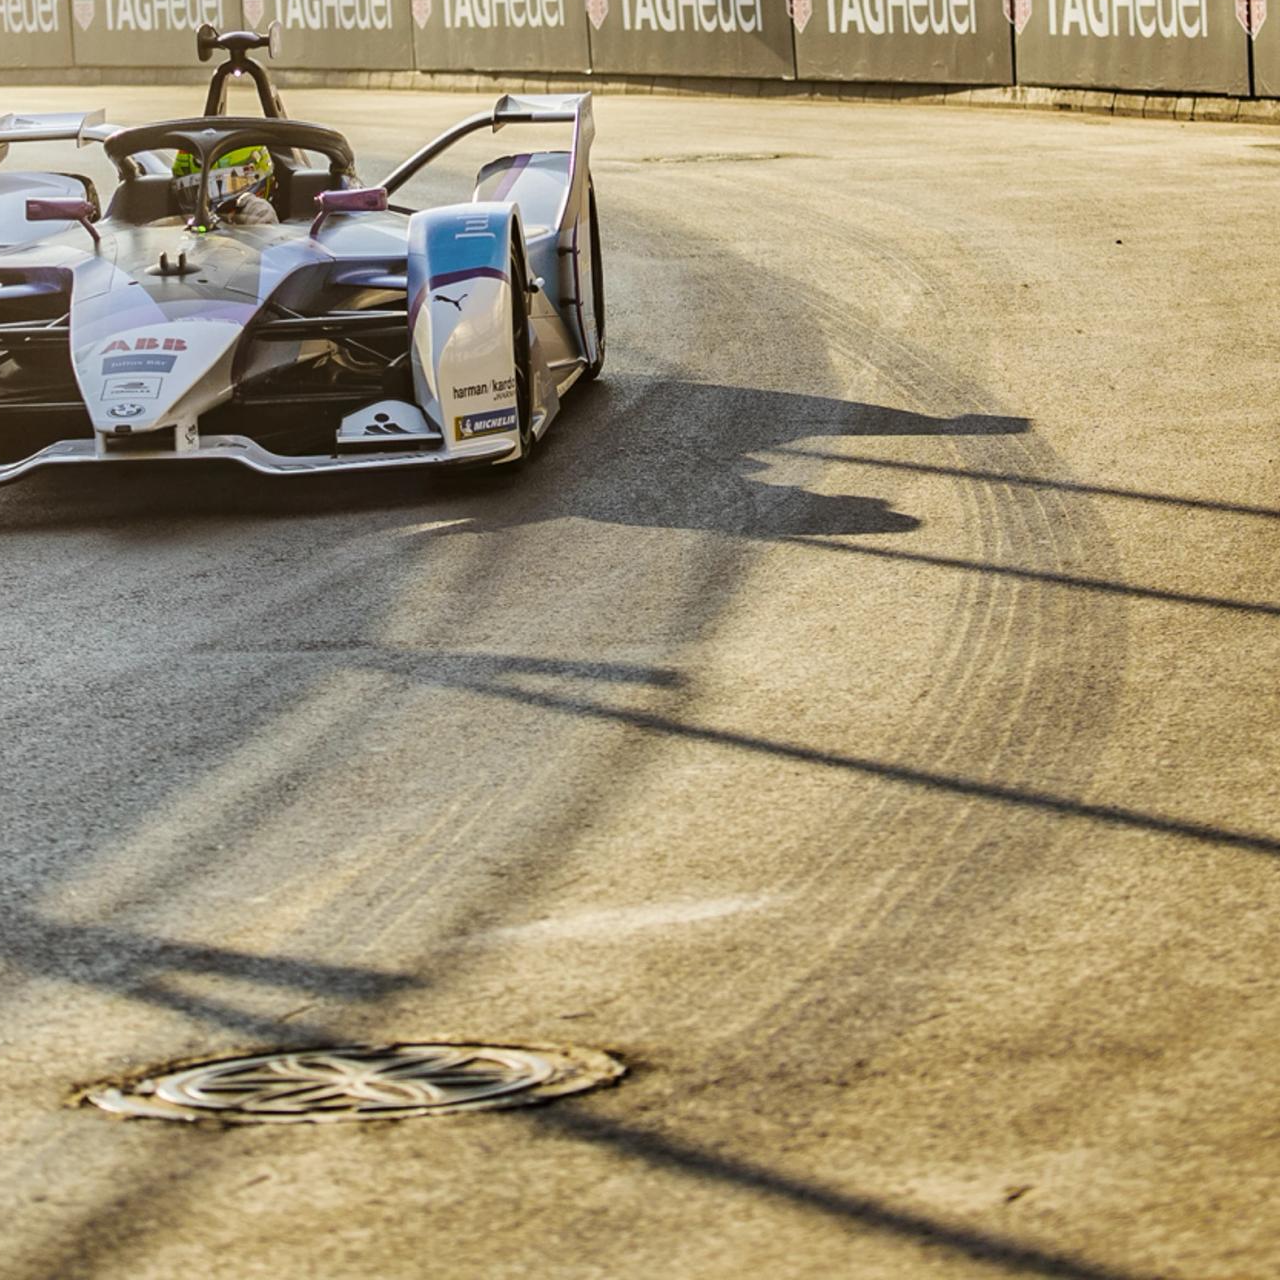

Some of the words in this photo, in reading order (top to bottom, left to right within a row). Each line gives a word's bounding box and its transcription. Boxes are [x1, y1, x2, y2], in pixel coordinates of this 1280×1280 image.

[99, 337, 188, 356] ABB
[452, 383, 488, 400] harman
[491, 377, 516, 392] kardo
[473, 415, 516, 432] MICHELIN
